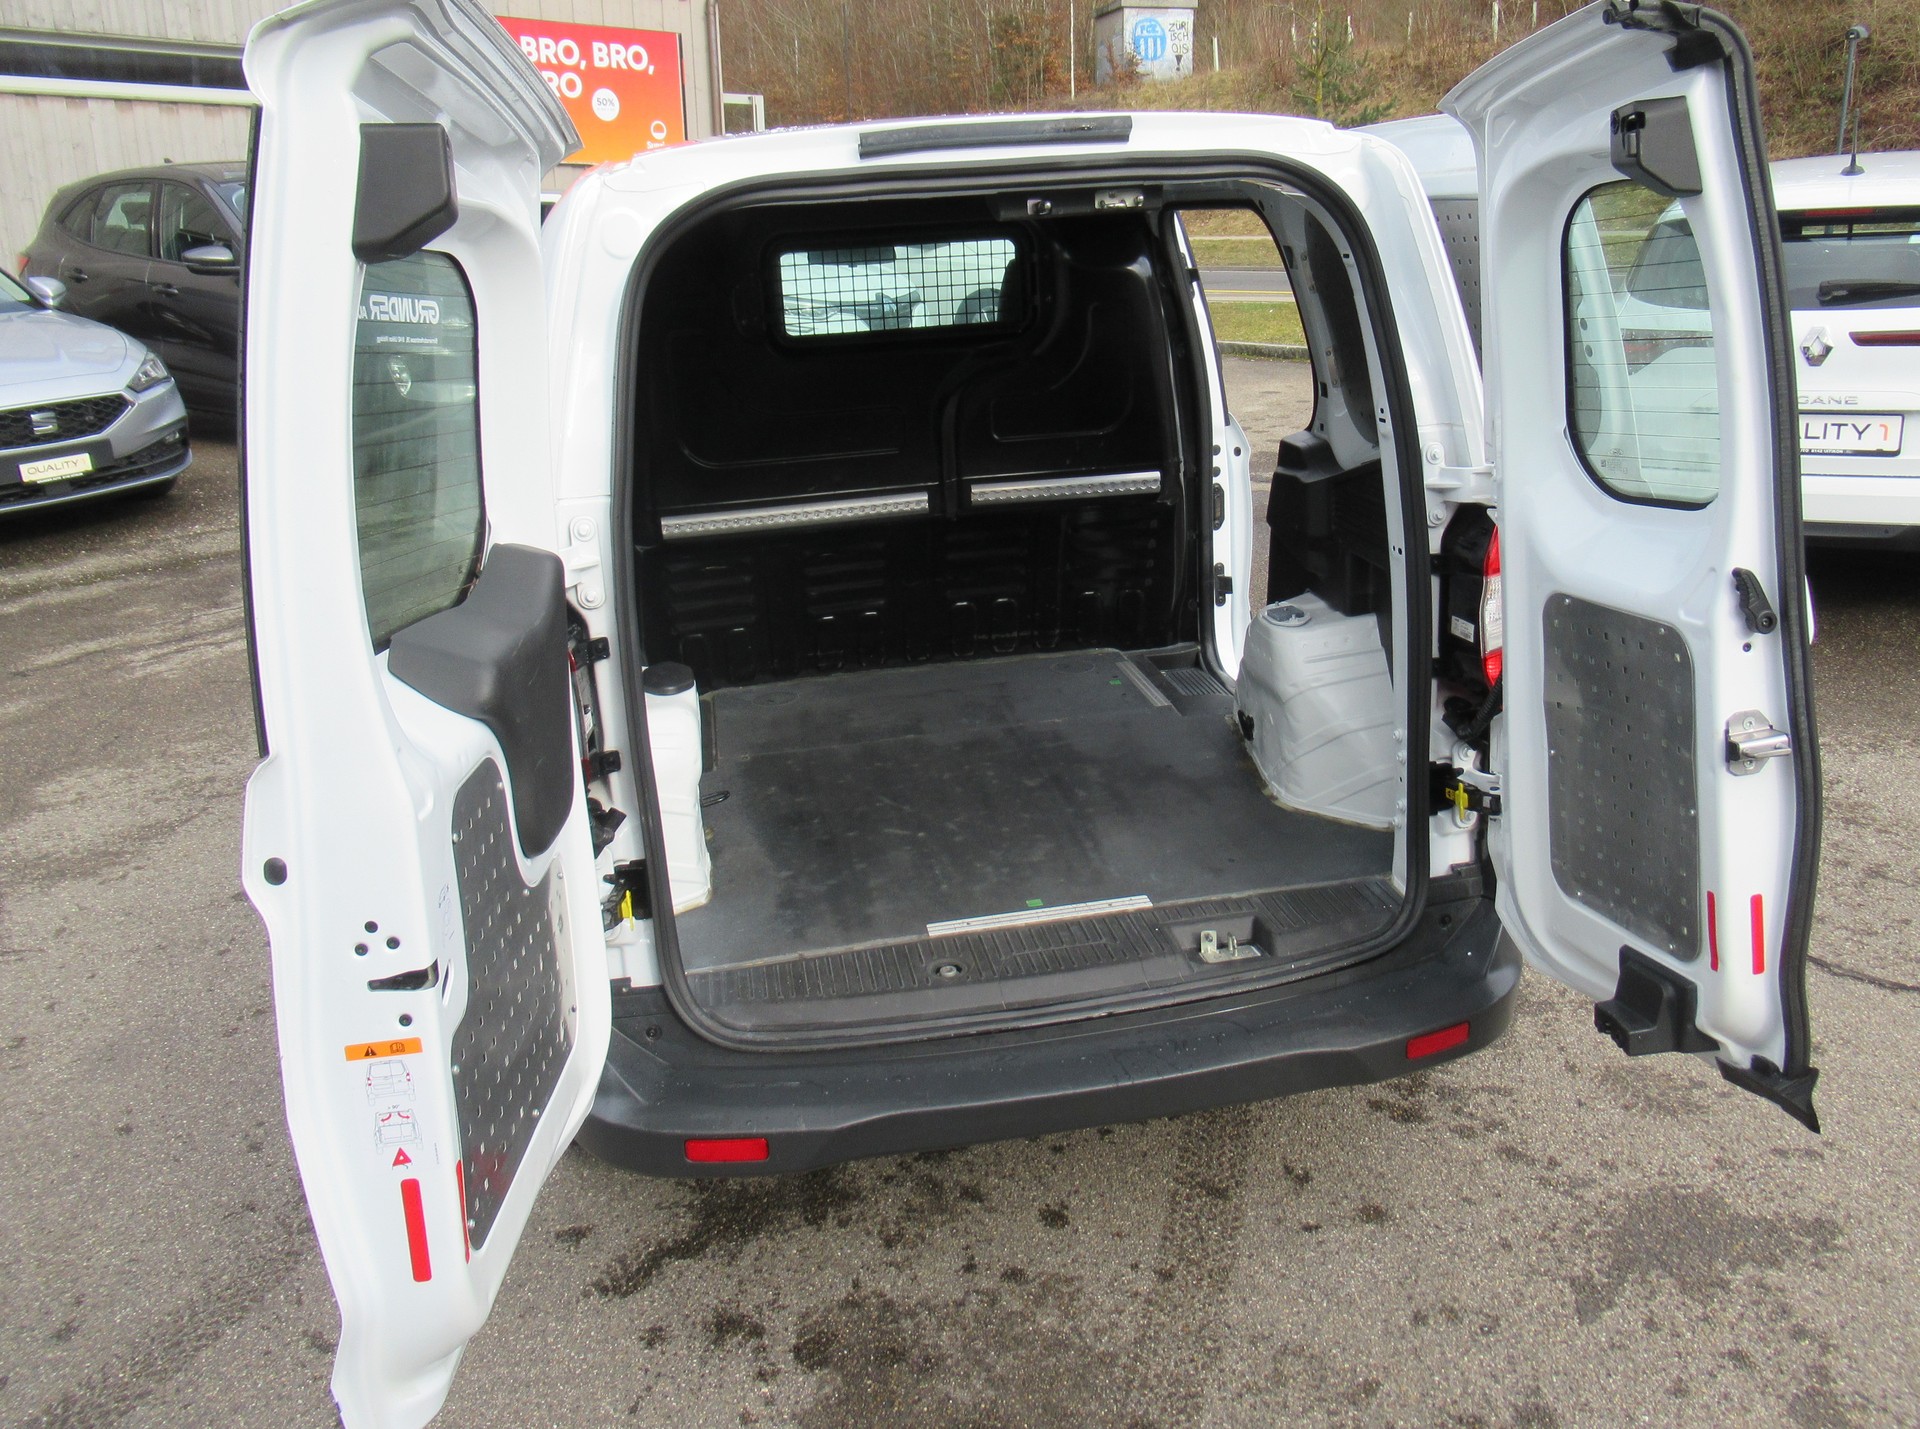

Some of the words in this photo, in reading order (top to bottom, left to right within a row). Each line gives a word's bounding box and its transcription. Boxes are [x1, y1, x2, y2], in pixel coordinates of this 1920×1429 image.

[520, 35, 586, 70] BRO,
[592, 41, 655, 75] BRO,
[541, 70, 583, 98] RO
[596, 97, 615, 107] 50%
[1798, 395, 1858, 405] GANE
[1799, 422, 1872, 441] LITY
[27, 460, 79, 475] QUALITY
